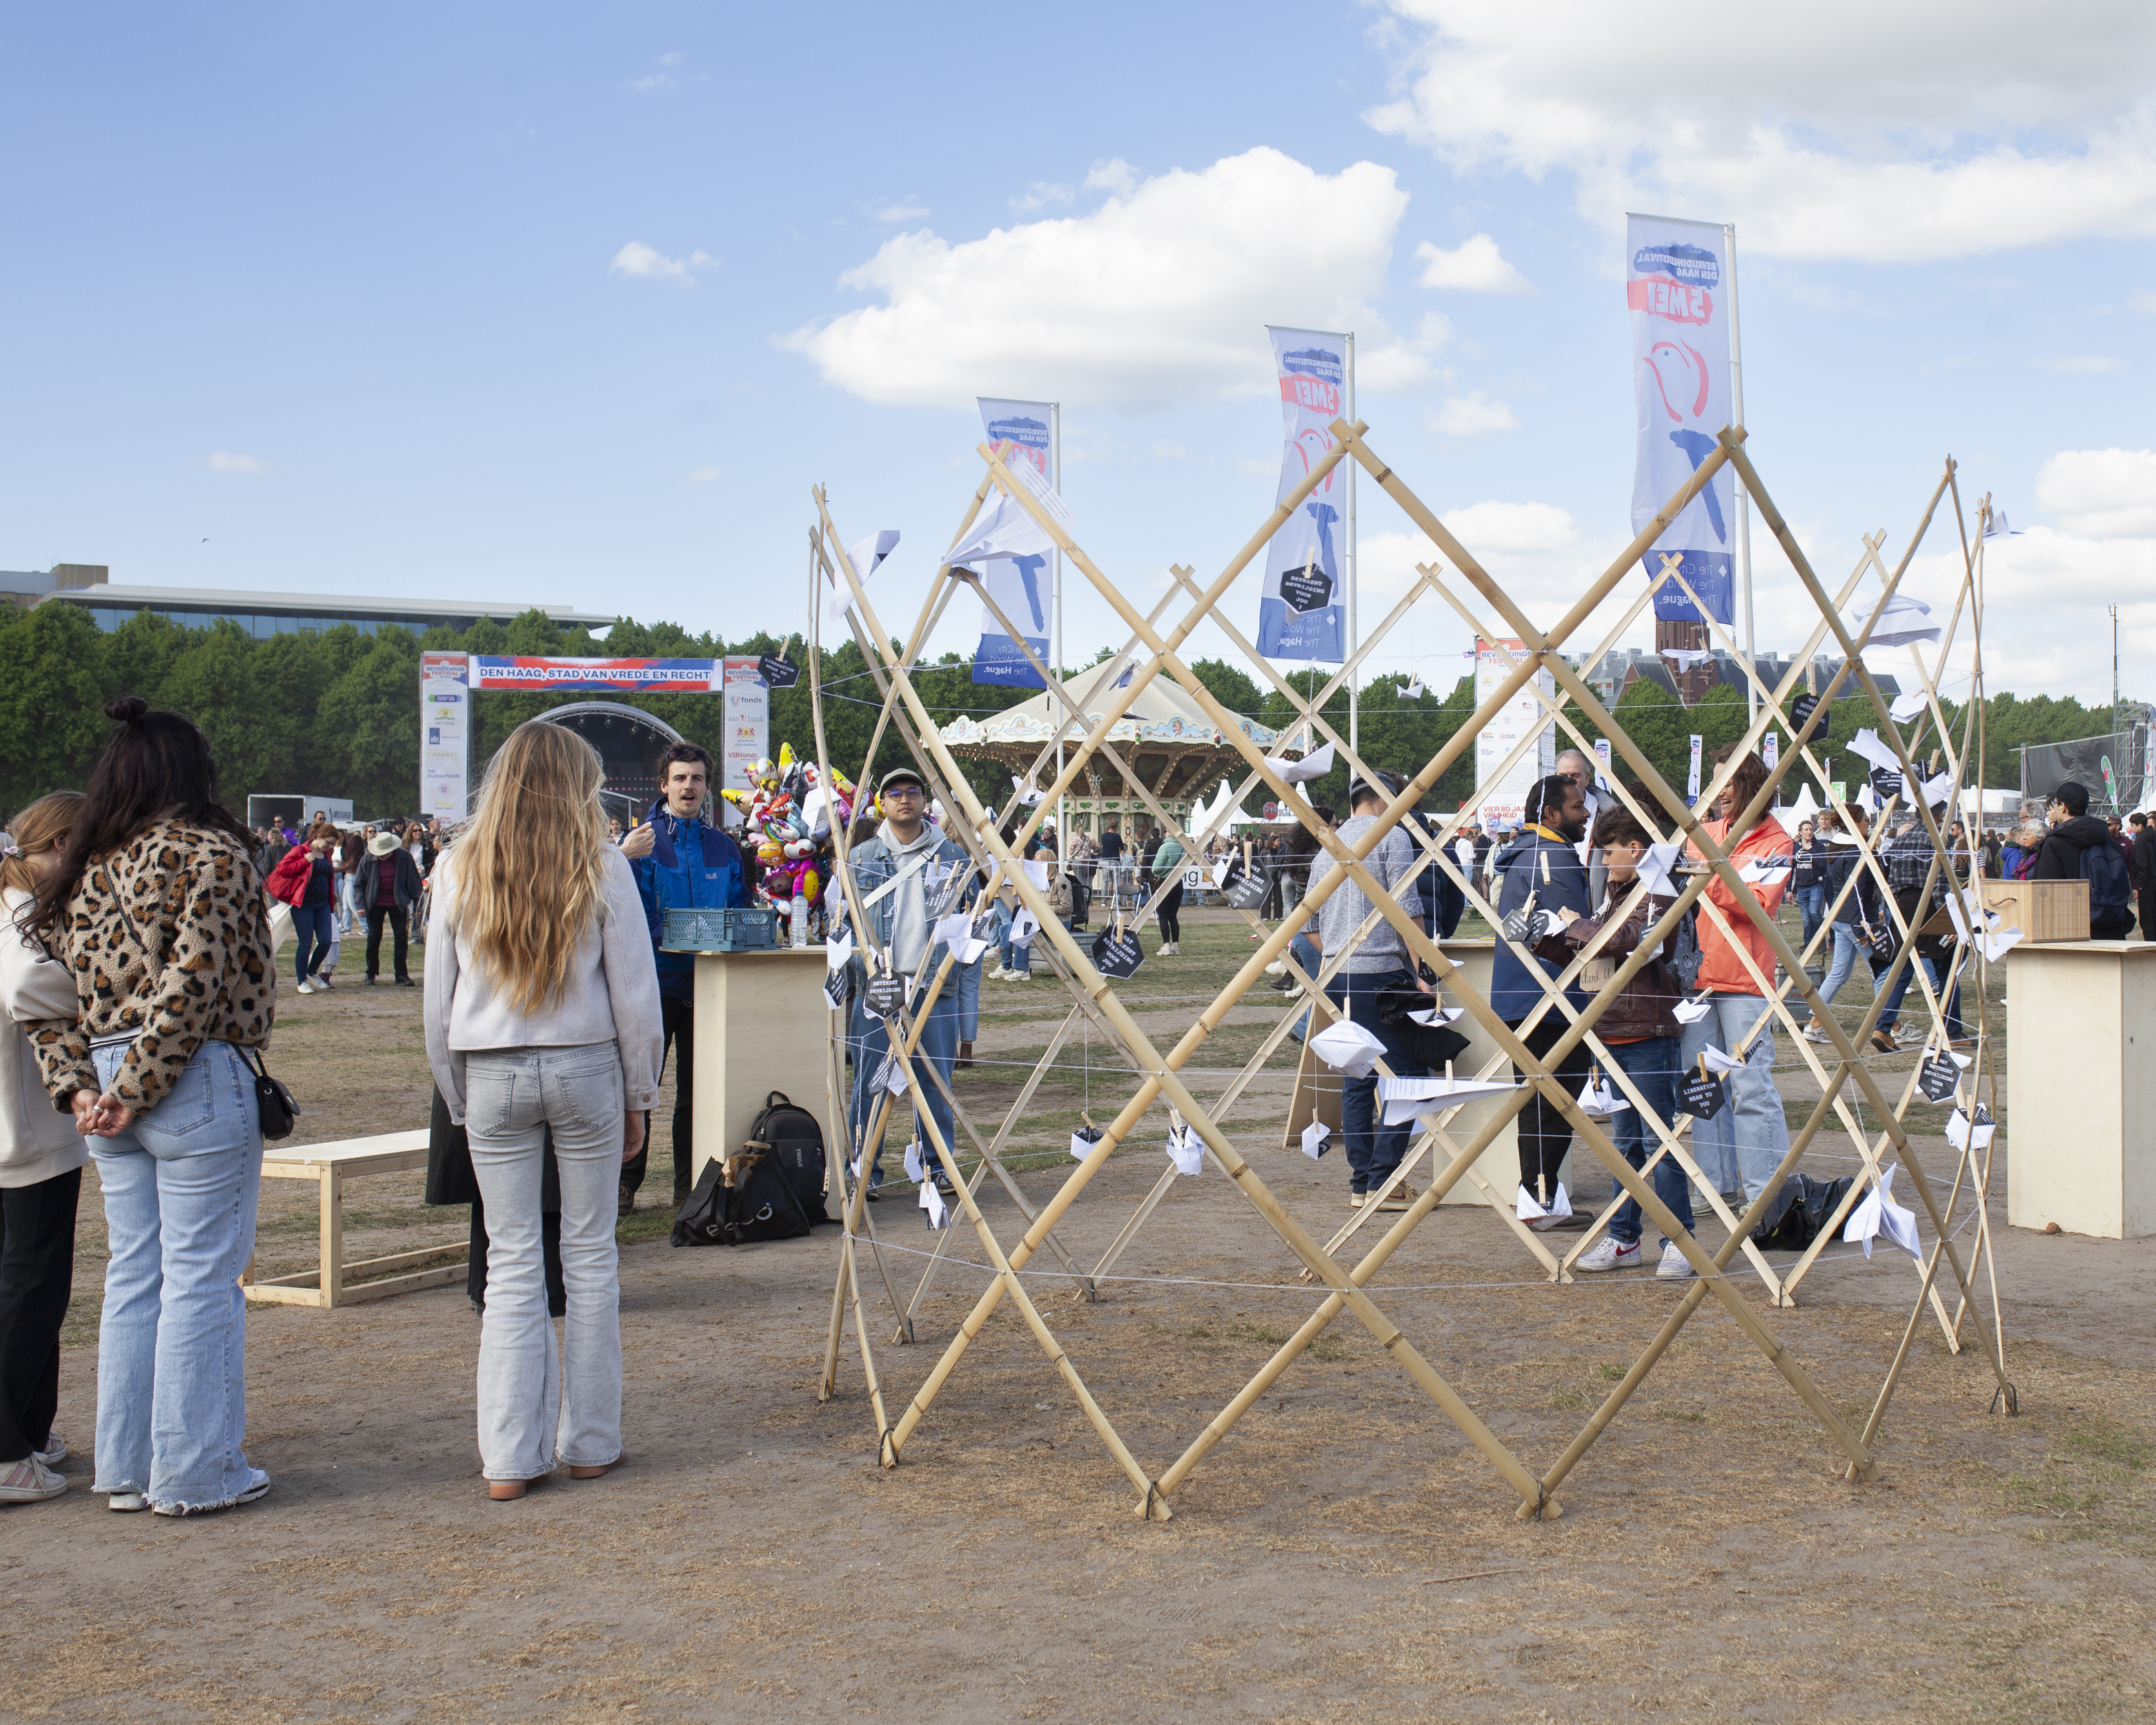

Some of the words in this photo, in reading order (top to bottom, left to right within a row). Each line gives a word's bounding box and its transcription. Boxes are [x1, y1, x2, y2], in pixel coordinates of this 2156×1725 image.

[1291, 575, 1323, 586] BETEKENT
[1285, 582, 1325, 594] BEVRIJDING
[1296, 590, 1312, 598] VOOR
[764, 658, 795, 673] LIBERATION
[480, 669, 504, 677] DEN
[507, 669, 546, 679] HAAG,
[583, 671, 607, 679] VAN
[611, 671, 650, 679] VREDE
[671, 671, 711, 680] RECHT
[1231, 873, 1264, 894] BEVRIJDING
[1238, 885, 1251, 896] VOOR
[1234, 894, 1245, 903] JOU
[1122, 934, 1134, 945] WAT
[1102, 937, 1134, 965] BEVRIJDING
[1102, 958, 1114, 967] JOU
[1106, 950, 1120, 964] VOOR
[1581, 967, 1600, 984] dank
[1923, 1070, 1955, 1083] BEVRIJDING
[1683, 1082, 1717, 1095] LIBERATION
[1931, 1079, 1944, 1087] VOOR
[1688, 1094, 1703, 1102] MEAN
